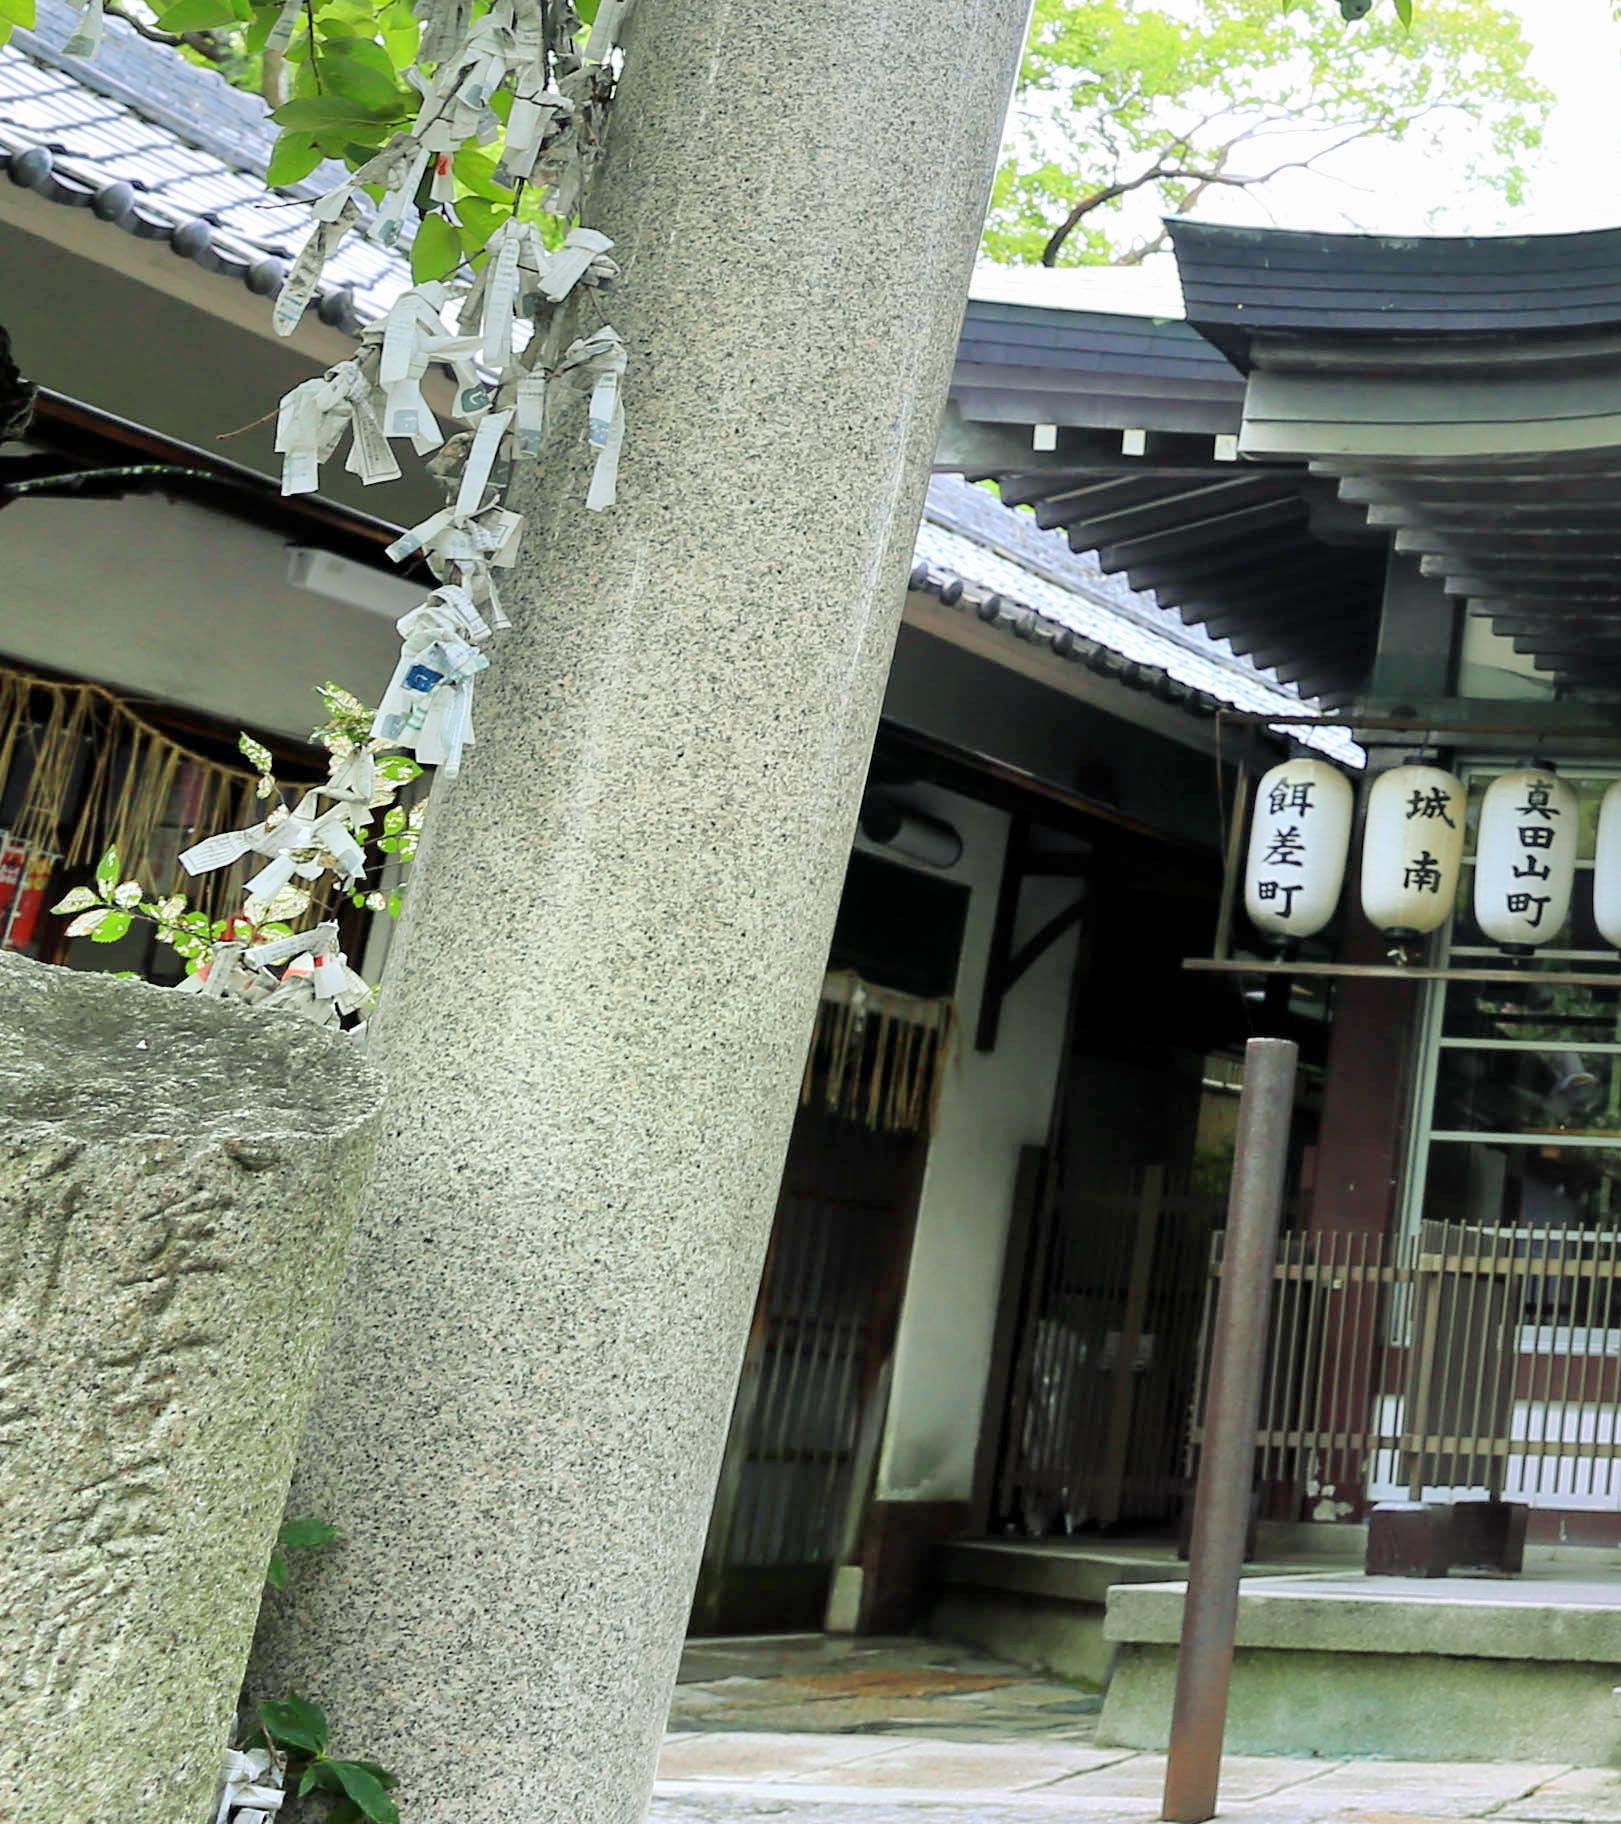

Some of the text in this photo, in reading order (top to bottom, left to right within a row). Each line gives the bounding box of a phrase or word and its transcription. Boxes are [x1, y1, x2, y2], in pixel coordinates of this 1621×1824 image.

[1258, 780, 1316, 918] 餌差町
[1404, 787, 1457, 894] 城南
[1506, 782, 1560, 926] 真田山町
